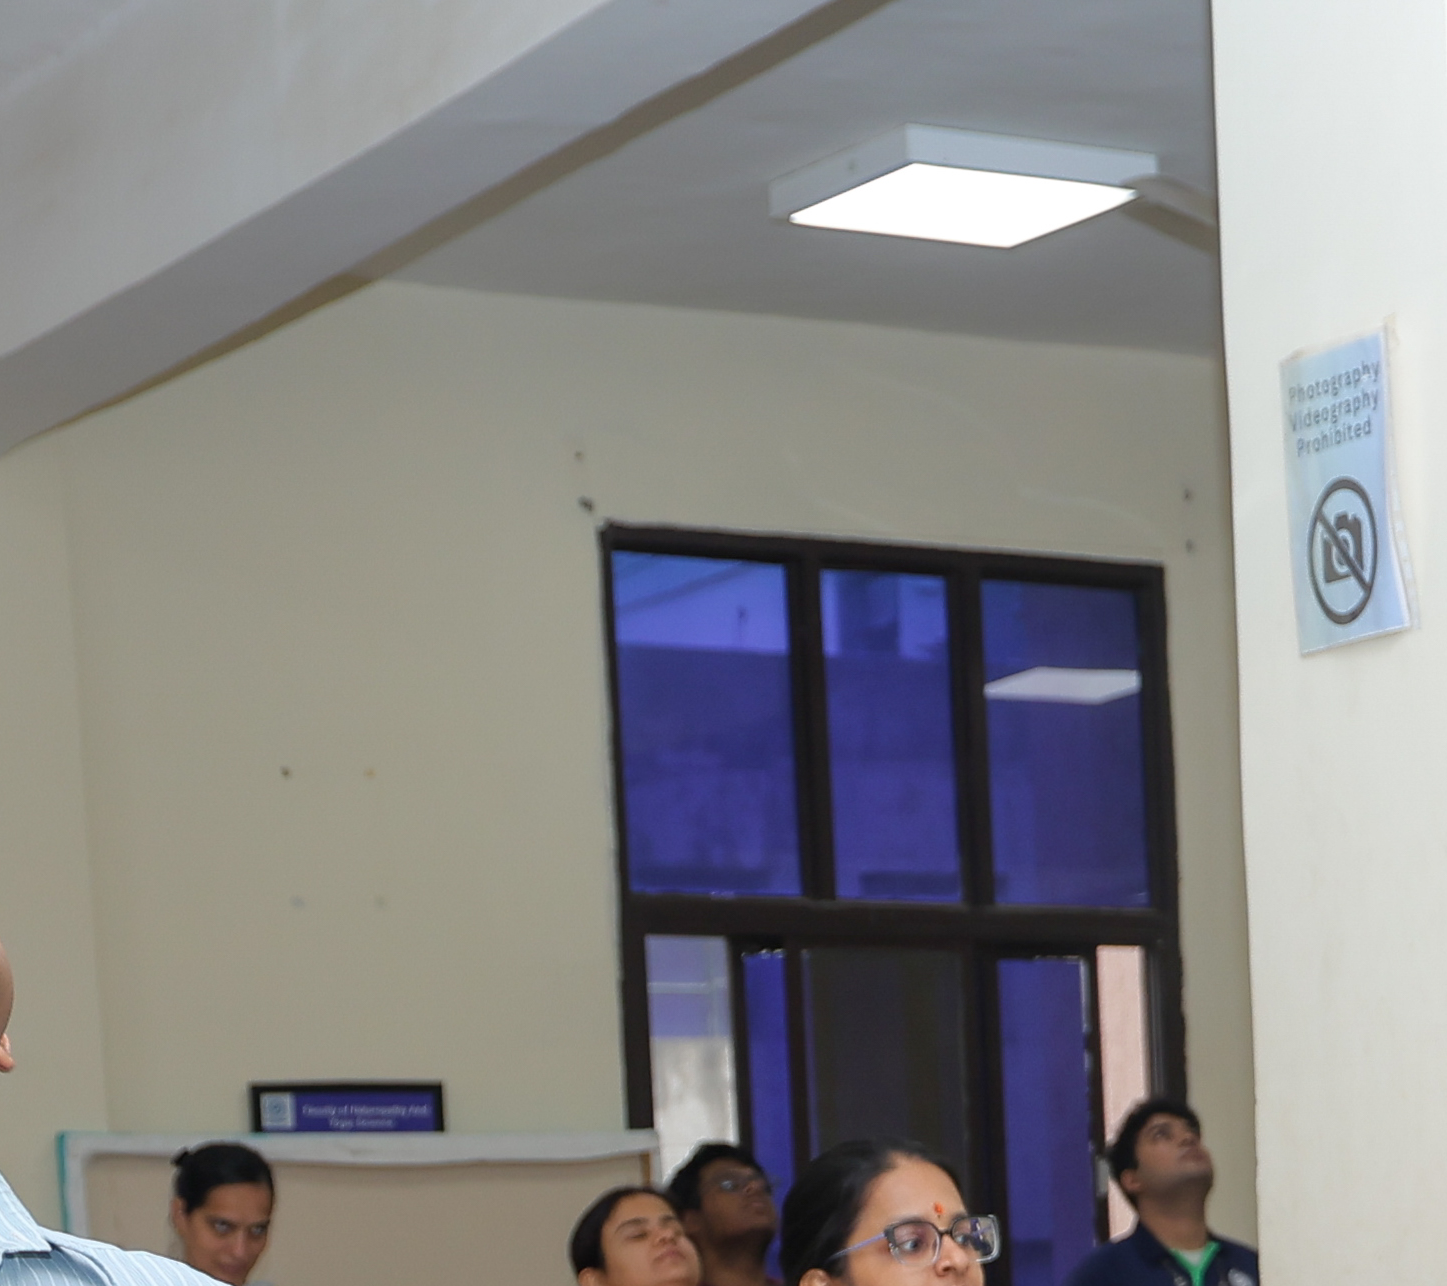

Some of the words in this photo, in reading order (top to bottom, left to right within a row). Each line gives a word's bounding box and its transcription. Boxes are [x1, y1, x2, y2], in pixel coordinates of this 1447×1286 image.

[1289, 360, 1381, 404] Photography
[1289, 388, 1380, 433] Videography
[1296, 416, 1372, 457] Prohibited
